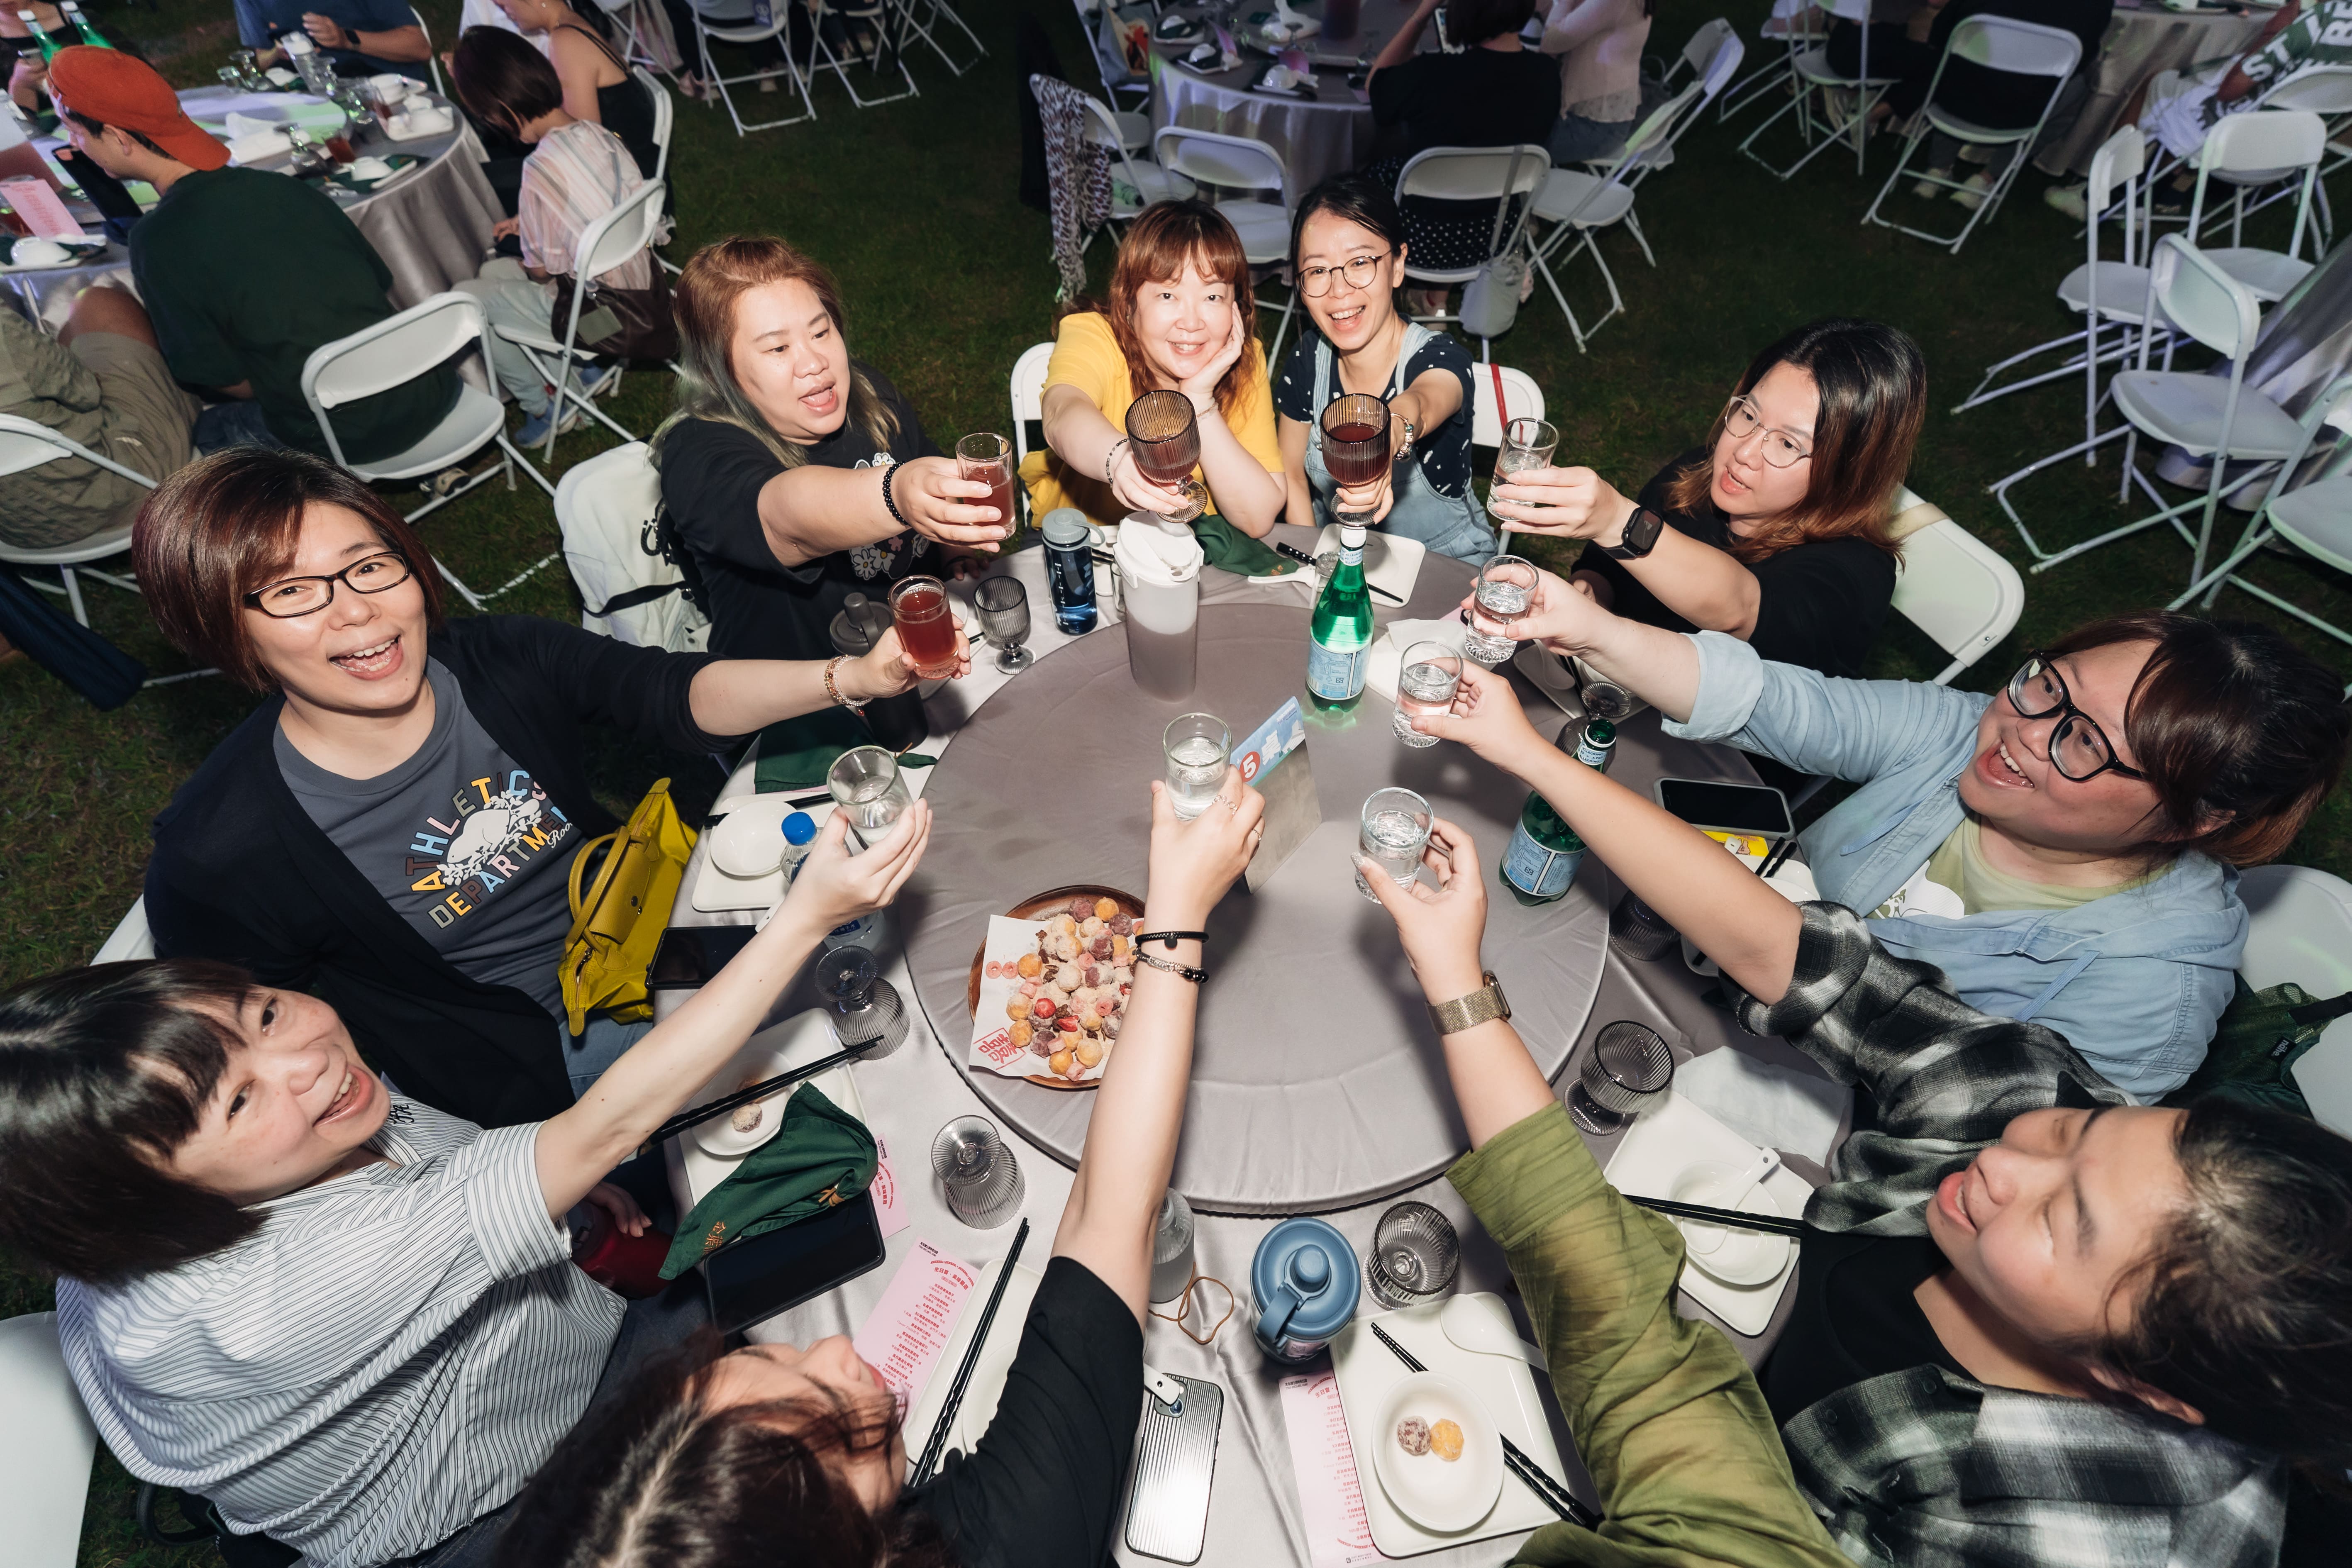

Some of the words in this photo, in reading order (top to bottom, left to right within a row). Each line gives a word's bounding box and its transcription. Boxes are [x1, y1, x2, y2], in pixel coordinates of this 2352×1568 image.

[1243, 754, 1256, 778] 5
[405, 770, 547, 891] ATHLETICS
[547, 822, 573, 848] Roo
[2273, 1039, 2289, 1056] nähe
